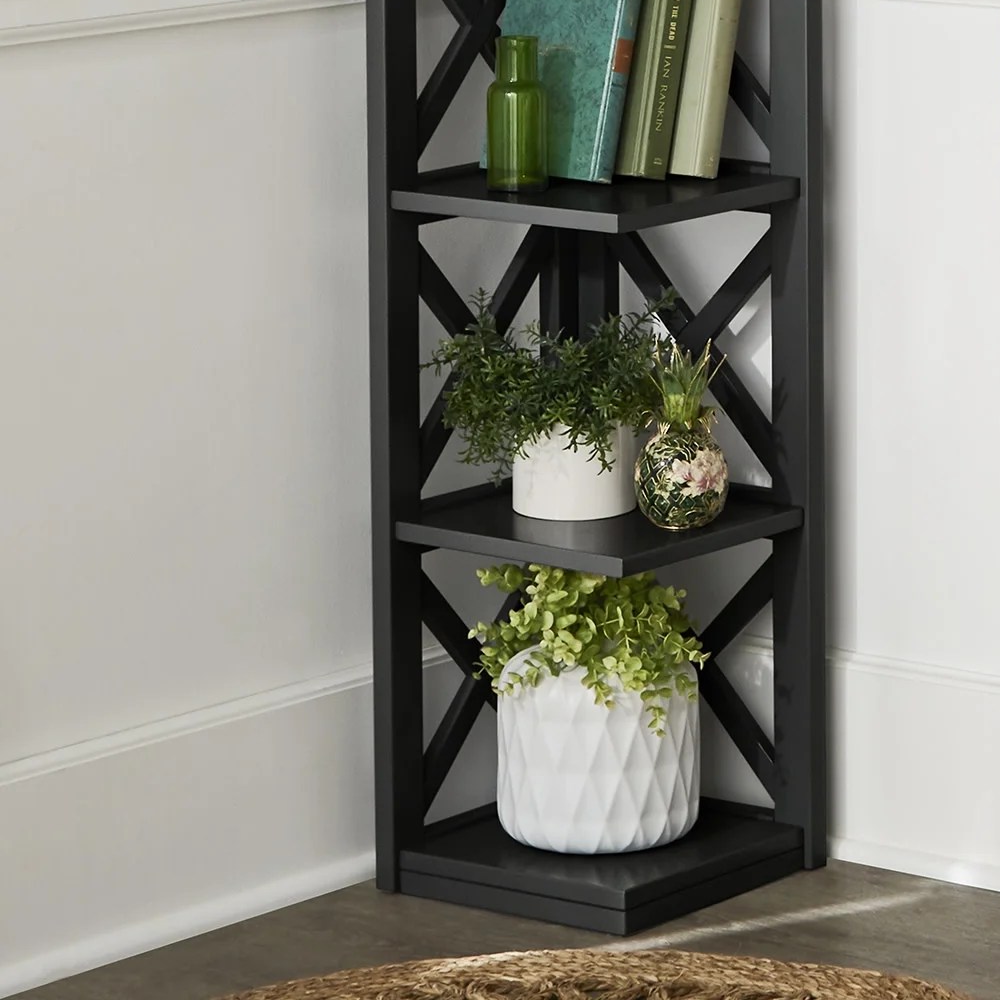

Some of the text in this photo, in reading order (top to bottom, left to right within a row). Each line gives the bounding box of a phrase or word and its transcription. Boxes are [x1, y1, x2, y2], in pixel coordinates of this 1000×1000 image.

[671, 6, 679, 18] THE
[668, 22, 677, 41] DEAD
[655, 56, 672, 132] IAN RANKIN
